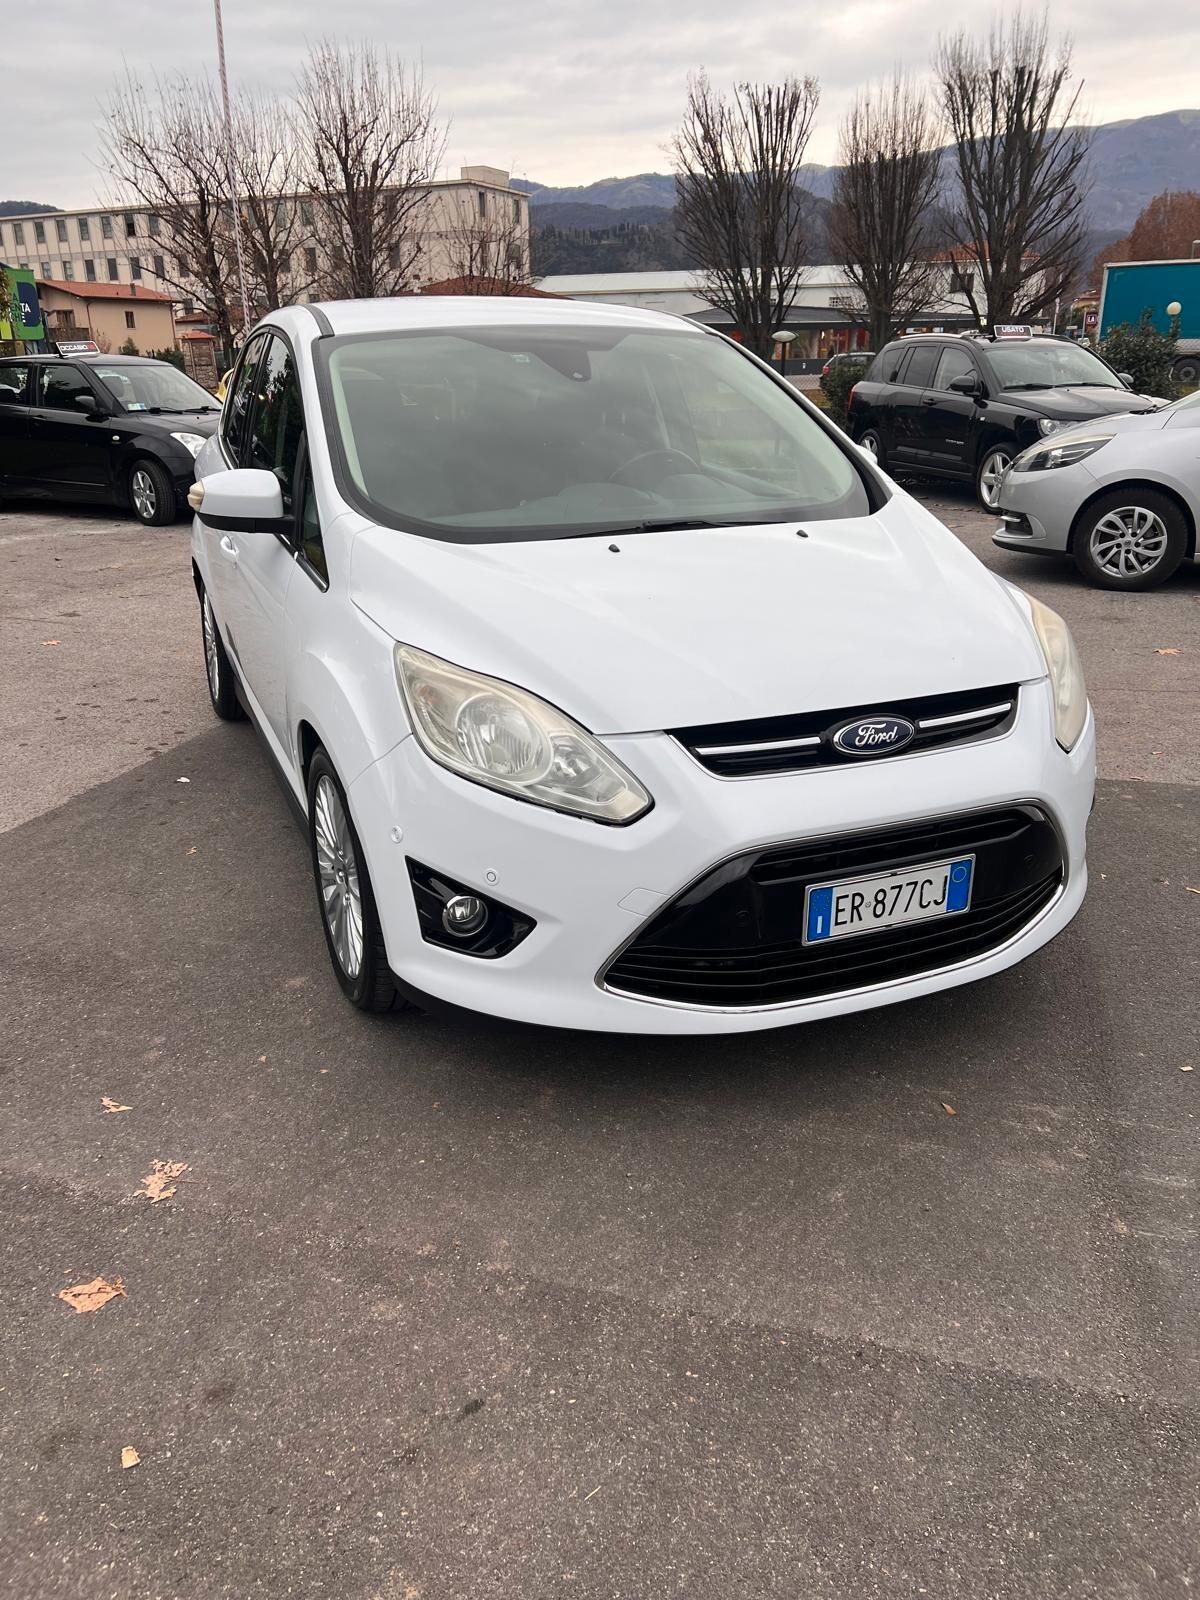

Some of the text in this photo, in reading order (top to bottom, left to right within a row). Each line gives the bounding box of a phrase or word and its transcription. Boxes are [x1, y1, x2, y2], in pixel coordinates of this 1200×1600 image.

[855, 722, 898, 747] Ford
[834, 892, 865, 927] ER
[872, 874, 948, 919] 877CJ
